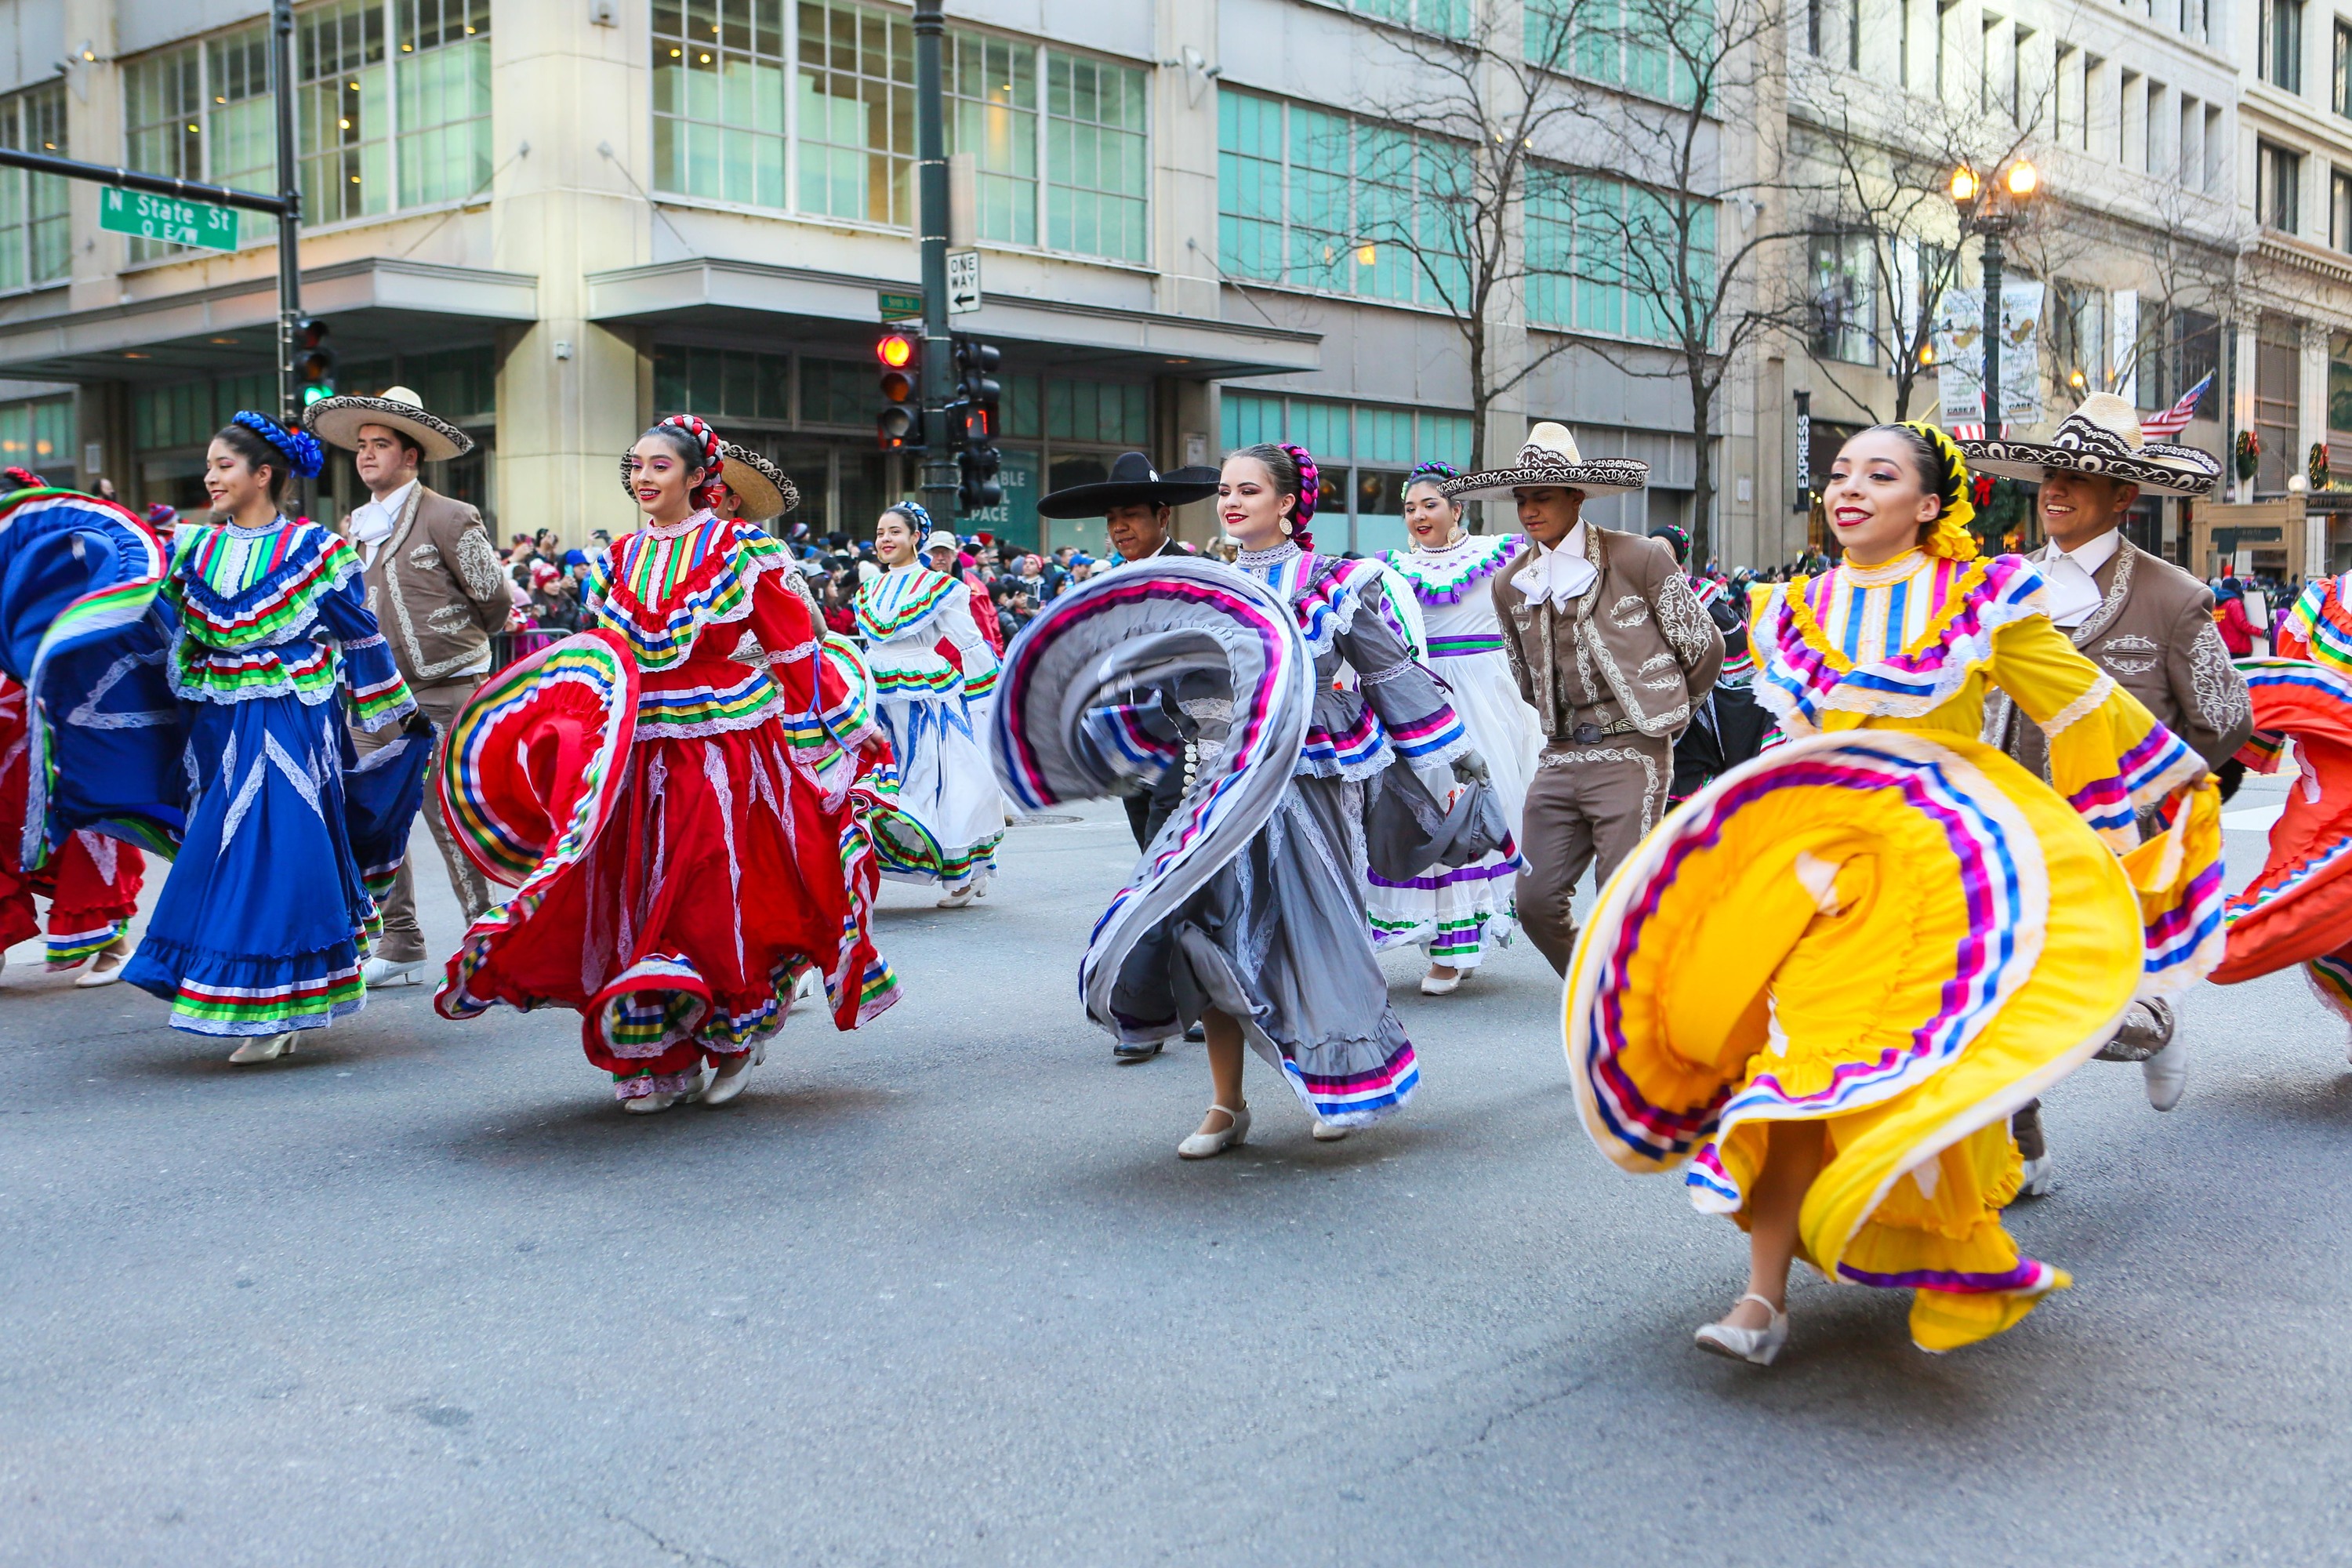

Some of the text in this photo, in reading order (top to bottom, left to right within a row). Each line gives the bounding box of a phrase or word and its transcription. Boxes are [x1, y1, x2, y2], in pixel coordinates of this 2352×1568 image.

[108, 190, 230, 231] N State St
[163, 223, 198, 244] E/W
[950, 256, 975, 273] ONE
[950, 274, 975, 289] WAY
[1798, 414, 1809, 488] EXPRESS
[989, 471, 1025, 487] ABLE
[964, 506, 1009, 522] PACE
